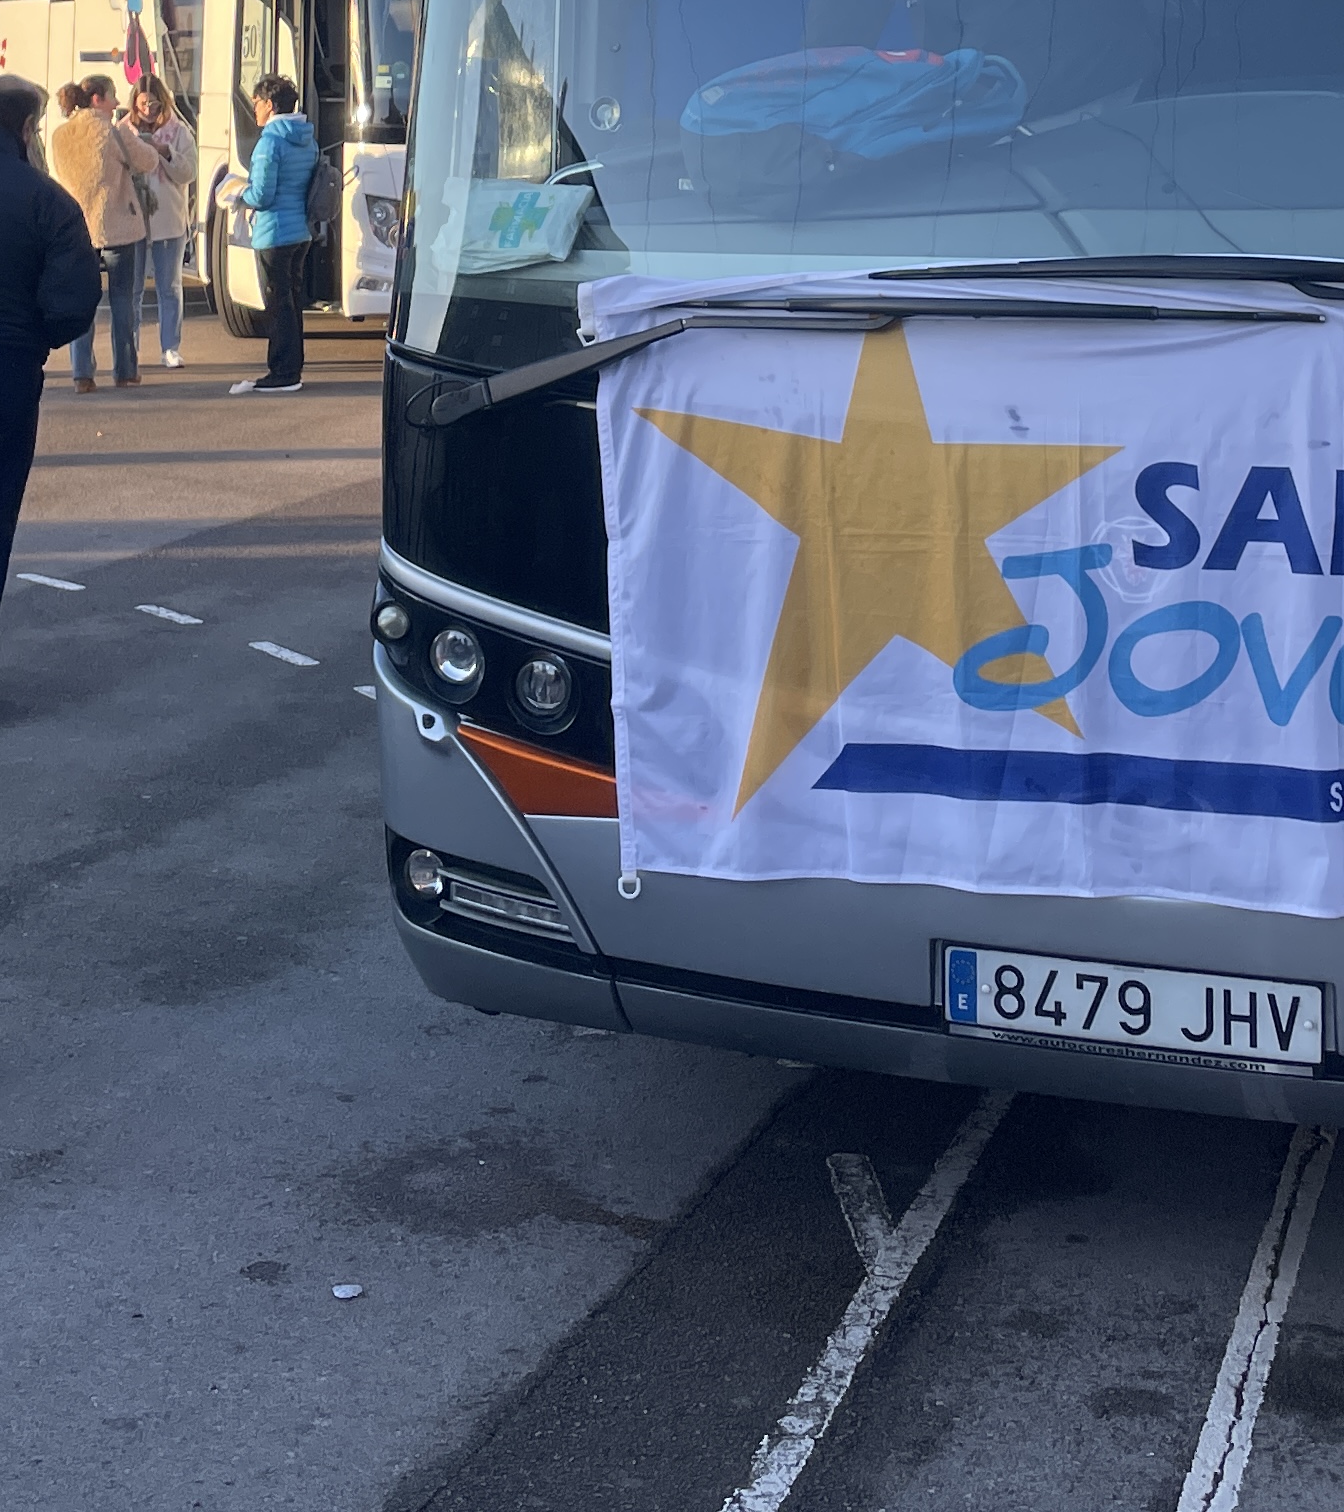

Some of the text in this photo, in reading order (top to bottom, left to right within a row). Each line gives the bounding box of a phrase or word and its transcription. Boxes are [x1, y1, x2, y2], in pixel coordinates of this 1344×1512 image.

[958, 994, 968, 1011] E
[994, 964, 1301, 1052] 8479 JHV
[992, 1031, 1266, 1072] www.autocareshernandez.com
